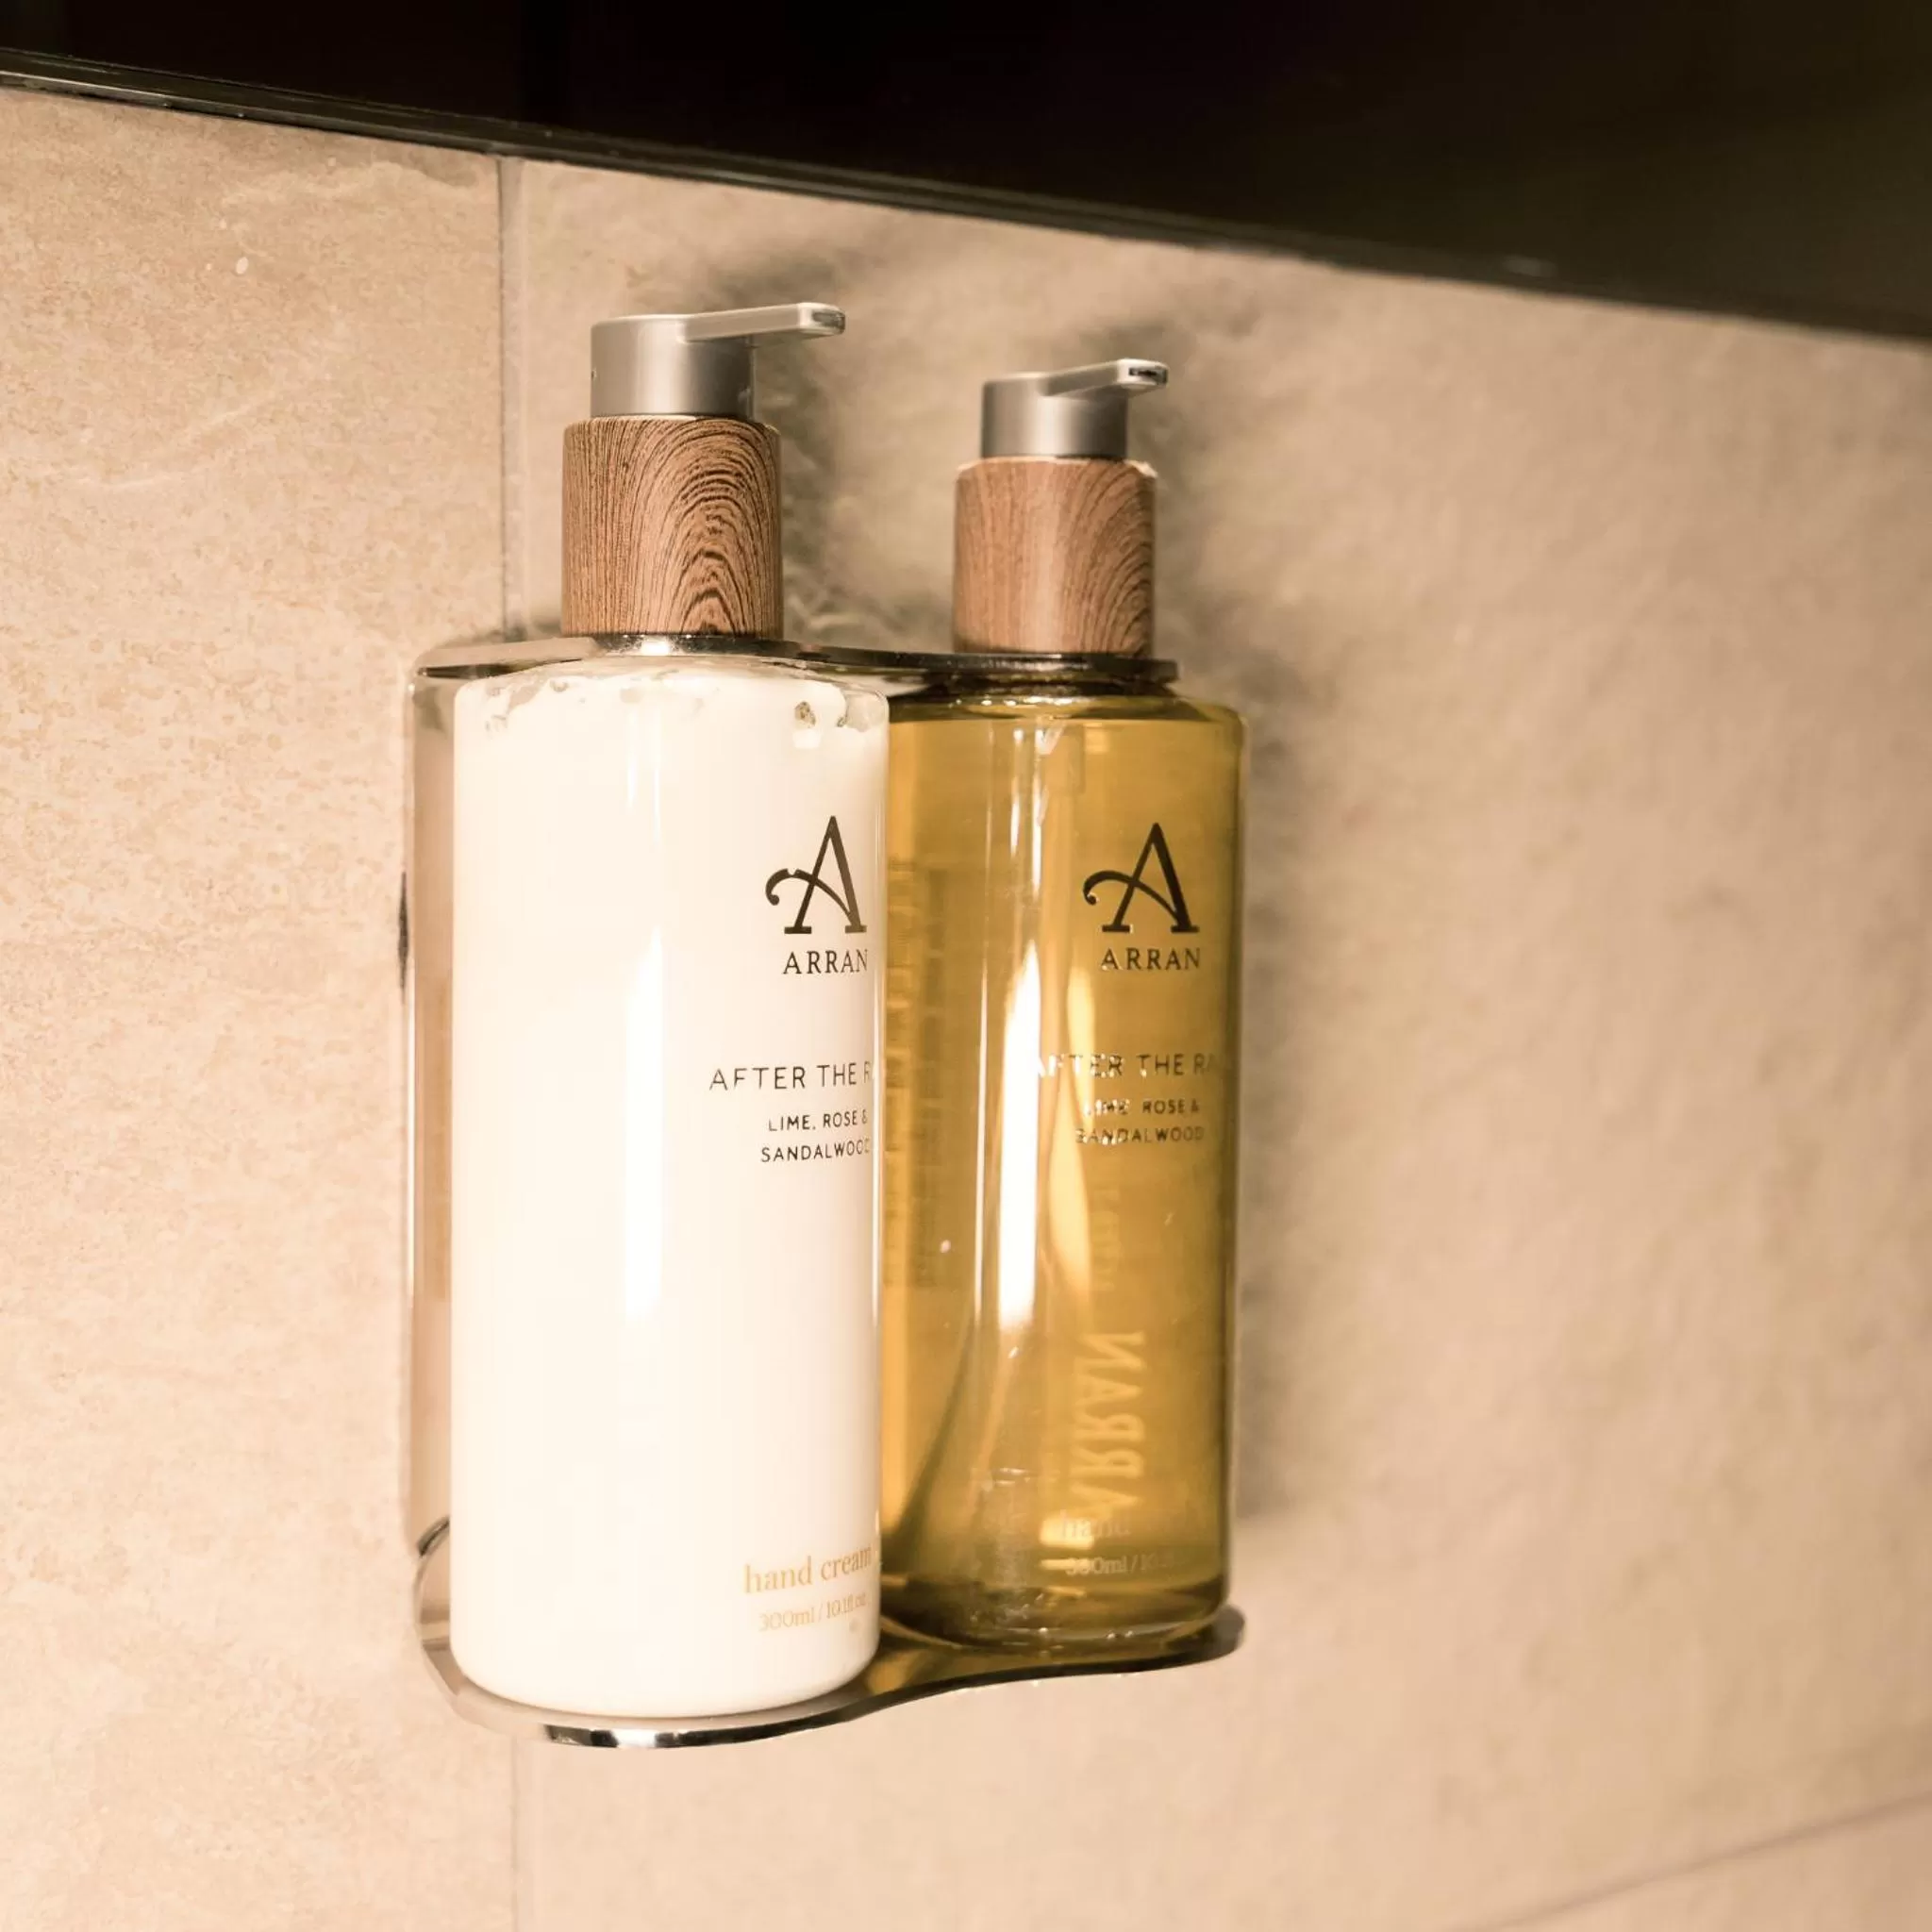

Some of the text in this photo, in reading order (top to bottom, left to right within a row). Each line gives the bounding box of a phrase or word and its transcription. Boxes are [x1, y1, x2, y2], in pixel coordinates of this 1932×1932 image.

[783, 949, 868, 974] ARRAN
[1101, 947, 1201, 971] ARRAN
[709, 1066, 807, 1091] AFTER
[816, 1062, 857, 1088] THE
[1136, 1053, 1185, 1076] THE
[1142, 1098, 1185, 1115] ROSE
[823, 1110, 858, 1128] ROSE
[744, 1545, 872, 1593] hand cream
